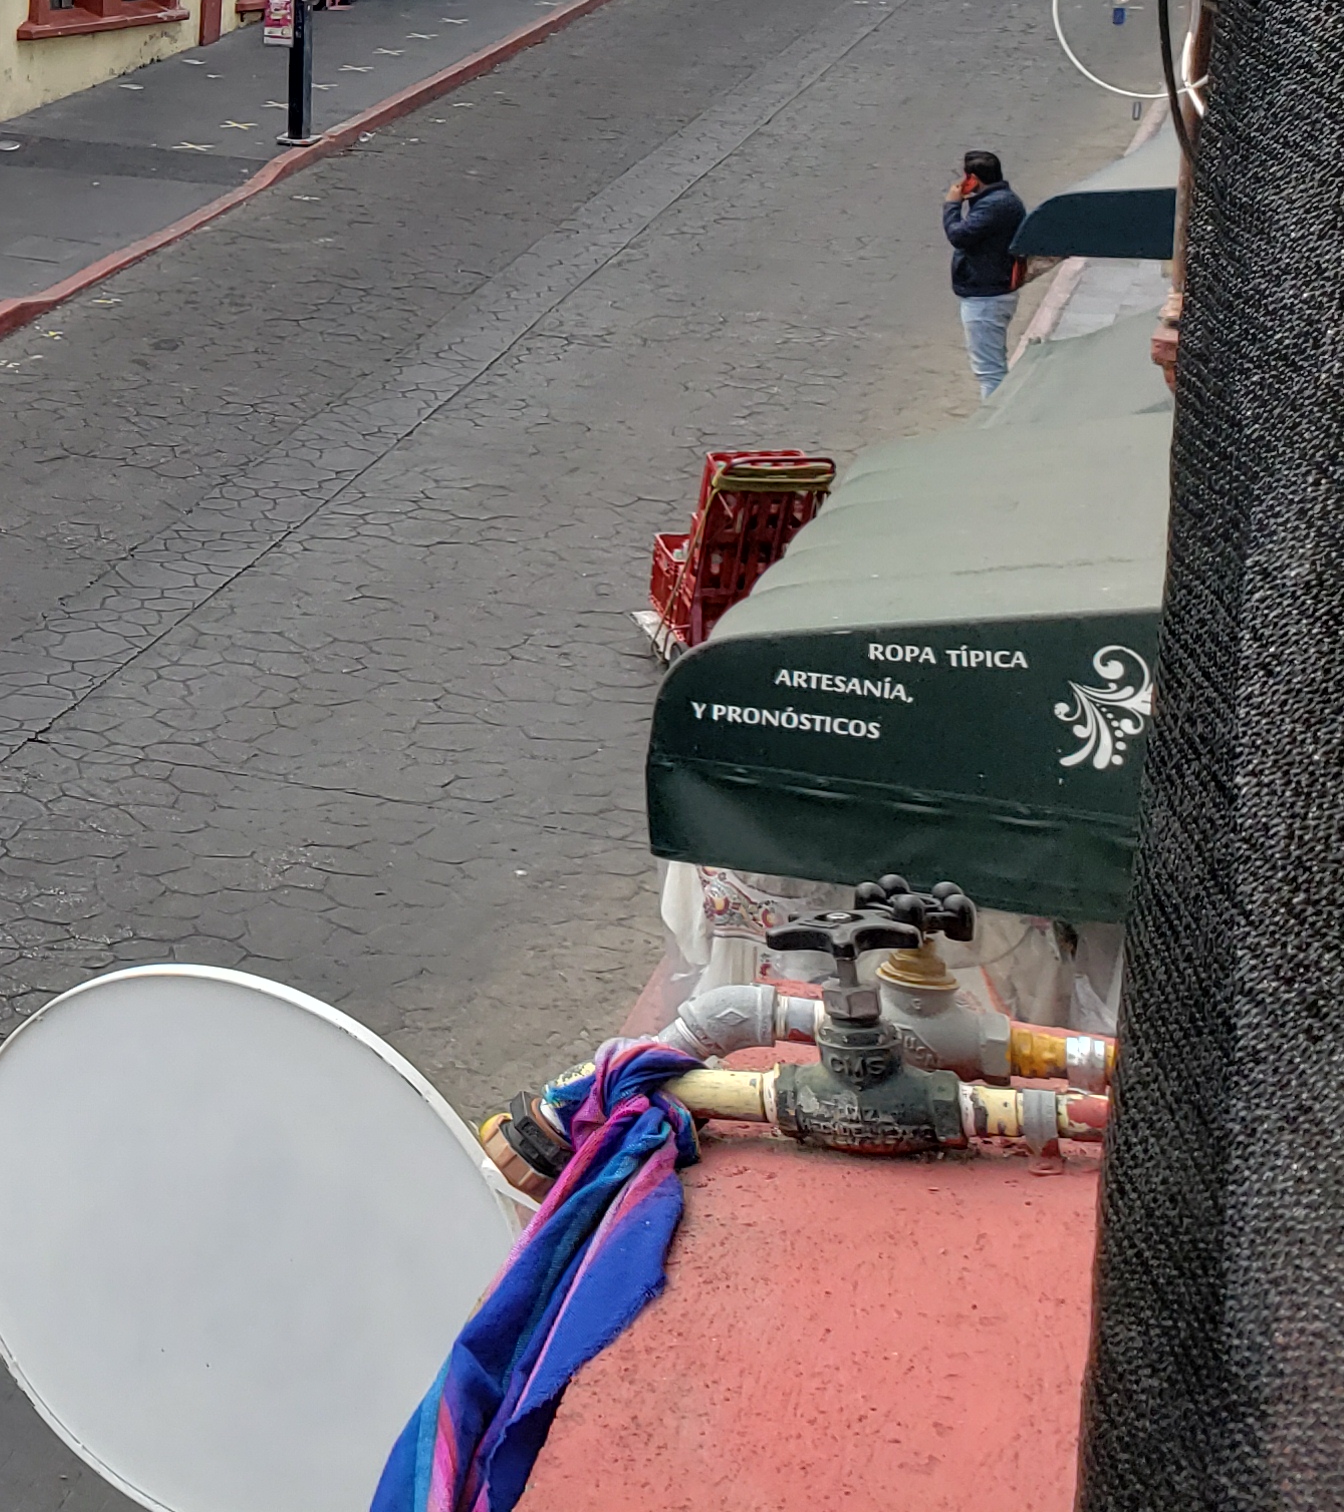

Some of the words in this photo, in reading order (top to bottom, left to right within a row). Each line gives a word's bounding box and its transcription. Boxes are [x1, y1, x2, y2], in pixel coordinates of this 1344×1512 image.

[868, 642, 937, 665] ROPA
[946, 644, 1029, 669] TÍPICA
[774, 668, 914, 704] ARTESANÍA,
[690, 701, 707, 720] Y
[712, 703, 881, 740] PRONÓSTICOS
